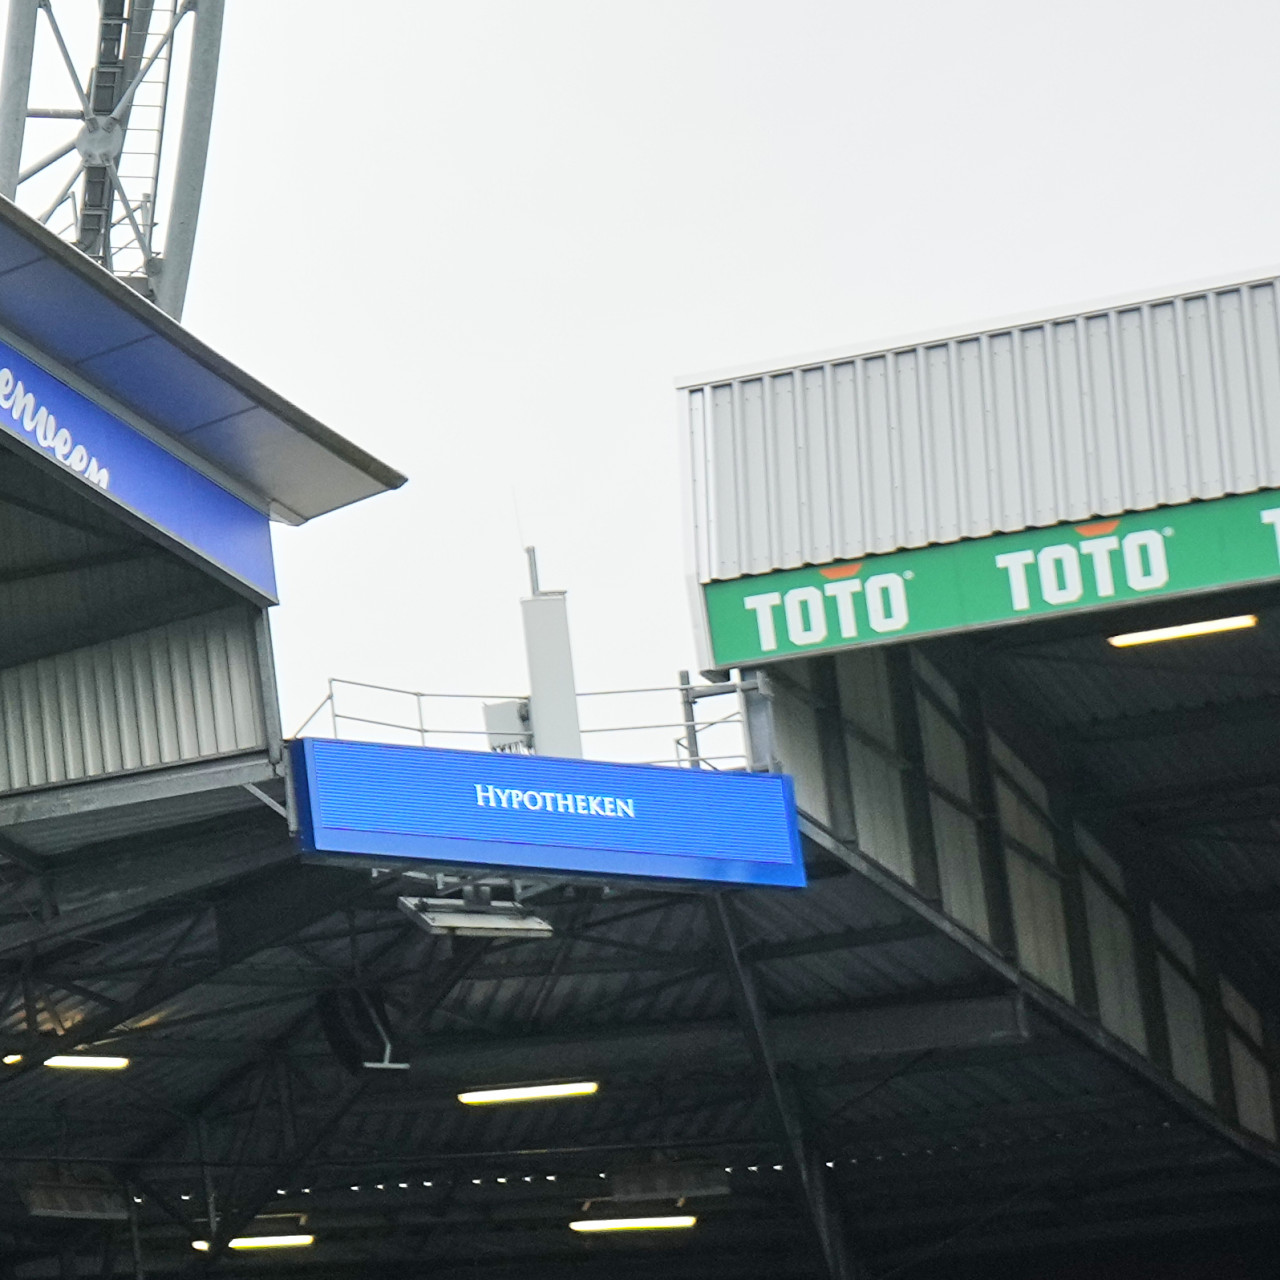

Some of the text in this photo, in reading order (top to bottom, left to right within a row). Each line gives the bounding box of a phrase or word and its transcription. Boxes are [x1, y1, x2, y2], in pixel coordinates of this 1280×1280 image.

[994, 528, 1170, 612] TOTO
[743, 571, 910, 652] TOTO
[473, 782, 636, 819] HYPOTHEKEN
